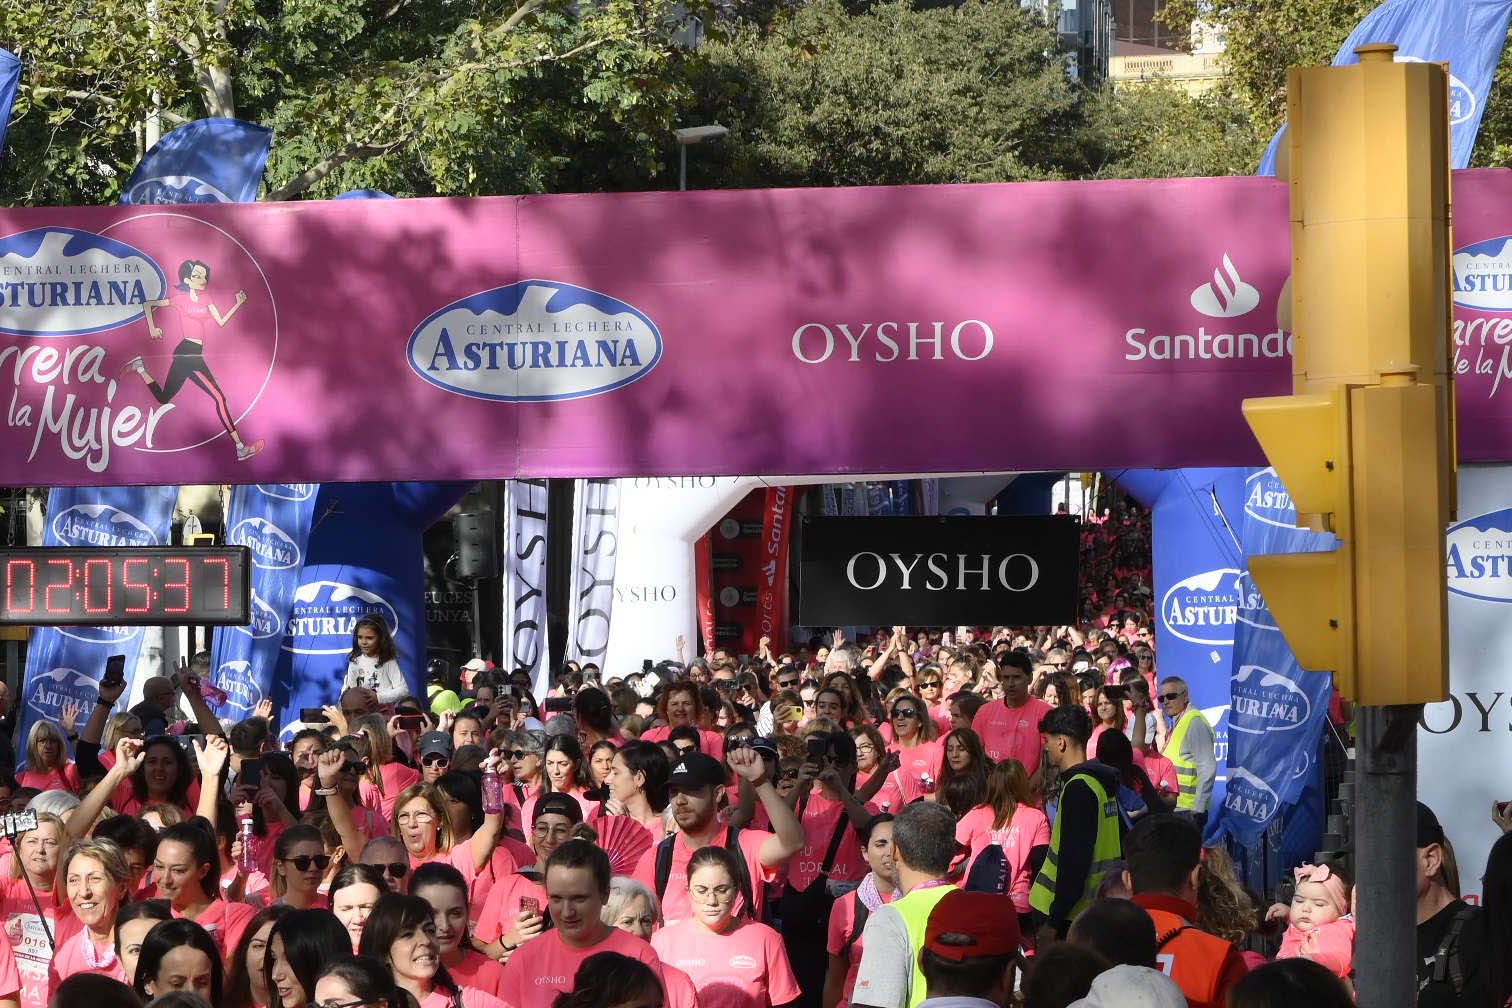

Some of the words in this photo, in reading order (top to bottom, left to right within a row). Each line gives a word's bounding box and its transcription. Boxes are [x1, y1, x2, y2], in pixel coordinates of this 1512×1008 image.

[70, 262, 142, 275] LECHERA
[466, 322, 545, 336] CENTRAL
[553, 320, 634, 334] LECHERA
[428, 326, 642, 372] ASTURIANA
[791, 319, 995, 364] OYSHO
[1475, 349, 1494, 377] la
[7, 389, 32, 428] la
[26, 376, 175, 473] Mujer
[846, 550, 1040, 592] OYSHO
[7, 559, 228, 613] 02:05:37
[616, 585, 676, 602] YSHO
[1185, 595, 1234, 604] CENTRAL
[294, 606, 331, 614] ENTRAL
[289, 617, 356, 636] STURIA
[1418, 691, 1512, 735] OY
[799, 861, 848, 875] DORAL
[24, 936, 46, 949] 016
